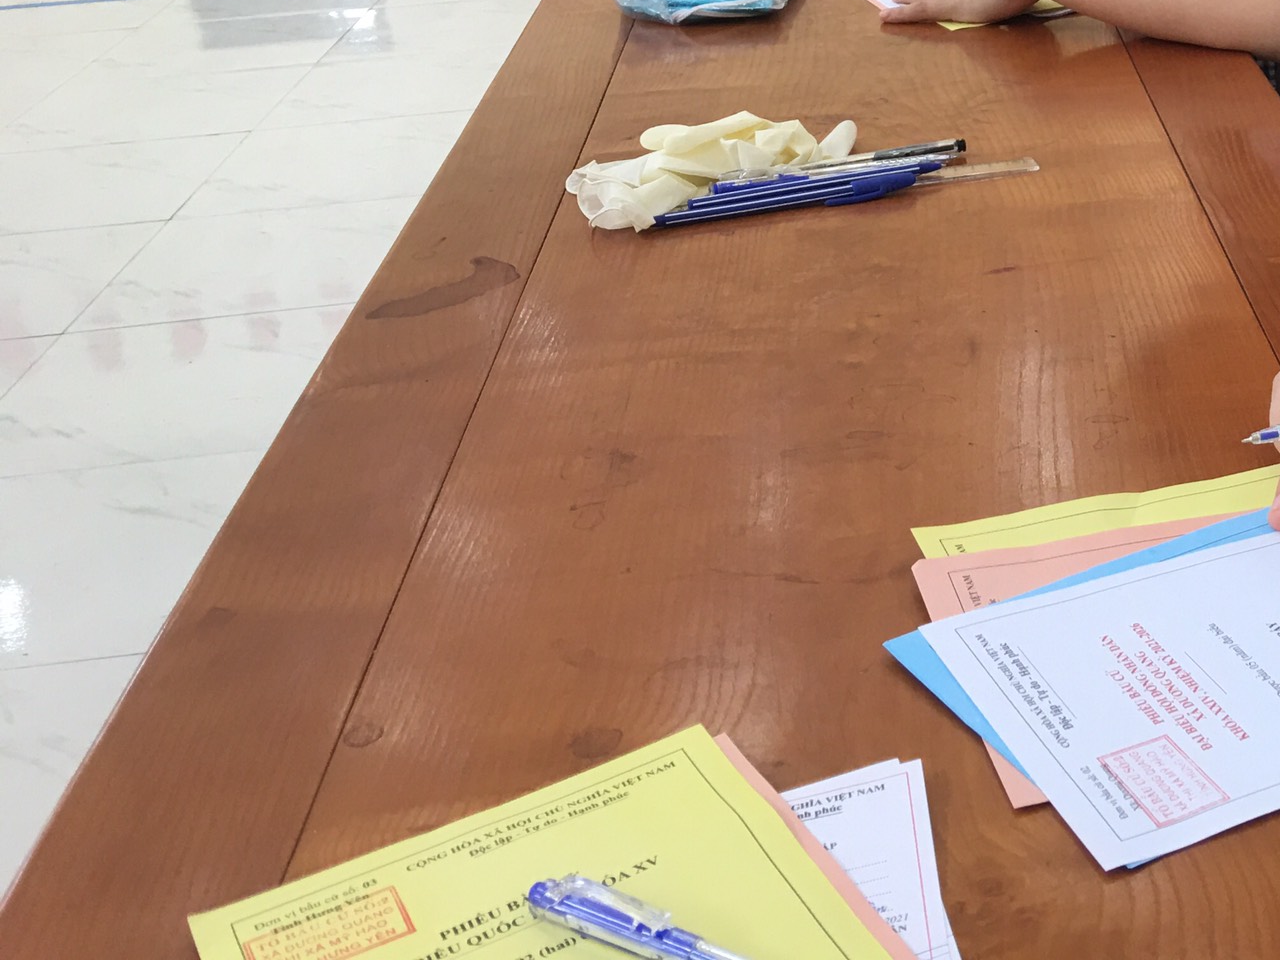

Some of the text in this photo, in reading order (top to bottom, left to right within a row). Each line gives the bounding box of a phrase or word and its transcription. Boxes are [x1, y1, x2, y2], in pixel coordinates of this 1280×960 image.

[1129, 622, 1166, 654] 2021-2026
[1207, 622, 1225, 636] biểu
[1218, 634, 1234, 645] đại
[999, 642, 1019, 659] phúc
[1157, 654, 1178, 667] KỲ
[1228, 643, 1253, 662] (năm)
[1010, 657, 1031, 677] Hạnh
[1245, 661, 1260, 670] 05
[1255, 668, 1272, 681] bầu
[1029, 680, 1042, 690] do
[1134, 650, 1207, 722] XÃ DƯƠNG QUANG
[1170, 665, 1204, 693] NHIỆM
[974, 633, 1071, 749] CỘNG HÒA XÃ HỘI CHỦ NGHĨA VIỆT NAM
[1036, 689, 1050, 700] Tự
[1101, 635, 1213, 751] ĐẠI BIỂU HỘI ĐỒNG NHÂN DÂN
[1104, 669, 1165, 726] PHIẾU BẦU CỬ
[1049, 704, 1063, 717] lập
[1058, 715, 1074, 730] Độc
[1221, 714, 1250, 742] KHÓA
[791, 783, 885, 812] GHĨA VIỆT NAM
[405, 760, 676, 872] CỘNG HÒA XÃ HỘI CHỦ NGHĨA VIỆT NAM
[814, 804, 843, 819] phúc
[468, 844, 492, 858] Độc
[493, 835, 513, 846] lập
[524, 824, 540, 834] Tự
[543, 818, 558, 827] do
[567, 803, 600, 818] Hạnh
[601, 791, 629, 806] phúc
[253, 917, 282, 931] Đơn
[298, 901, 322, 913] bầu
[324, 894, 339, 904] cử
[342, 885, 357, 897] số:
[362, 878, 378, 889] 03
[305, 903, 342, 922] Hưng
[345, 892, 369, 905] Yên
[466, 915, 524, 947] QUỐC
[601, 871, 632, 887] ÓA
[632, 855, 658, 875] XV
[439, 907, 501, 941] PHIẾU
[506, 893, 533, 912] BẦ
[365, 927, 397, 944] YÊN
[539, 937, 577, 958] (hai)
